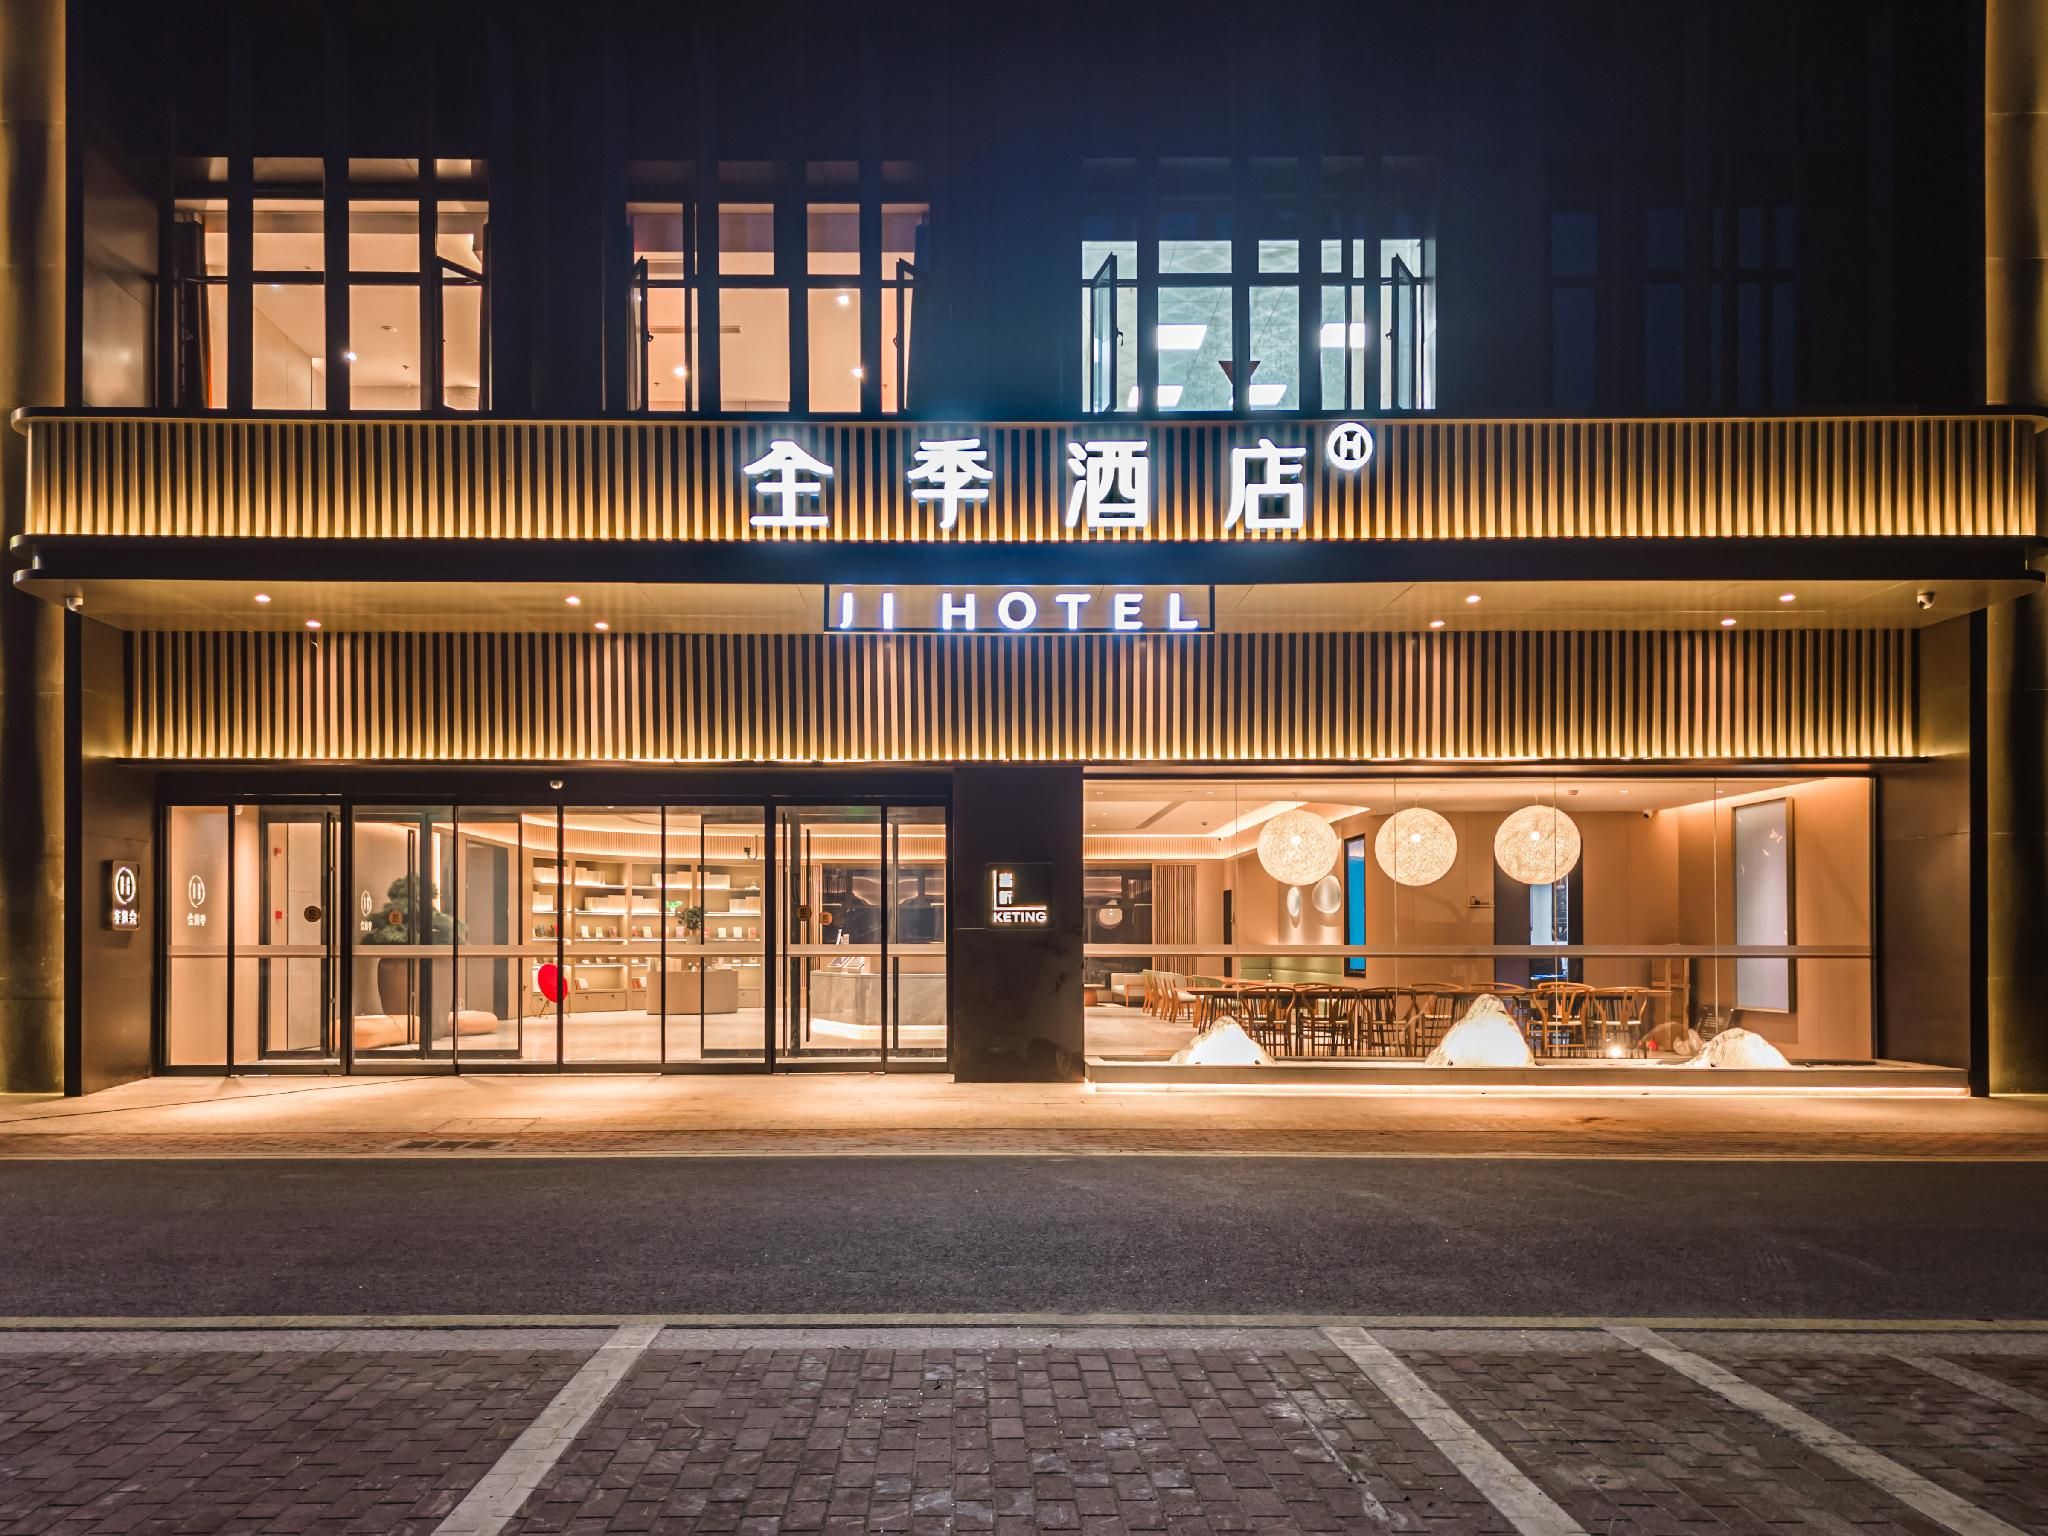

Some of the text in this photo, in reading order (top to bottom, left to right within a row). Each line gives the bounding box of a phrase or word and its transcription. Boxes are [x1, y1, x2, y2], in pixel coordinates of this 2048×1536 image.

[742, 439, 1307, 530] 全季酒店
[839, 591, 1199, 631] JI HOTEL
[993, 911, 1048, 923] KETING
